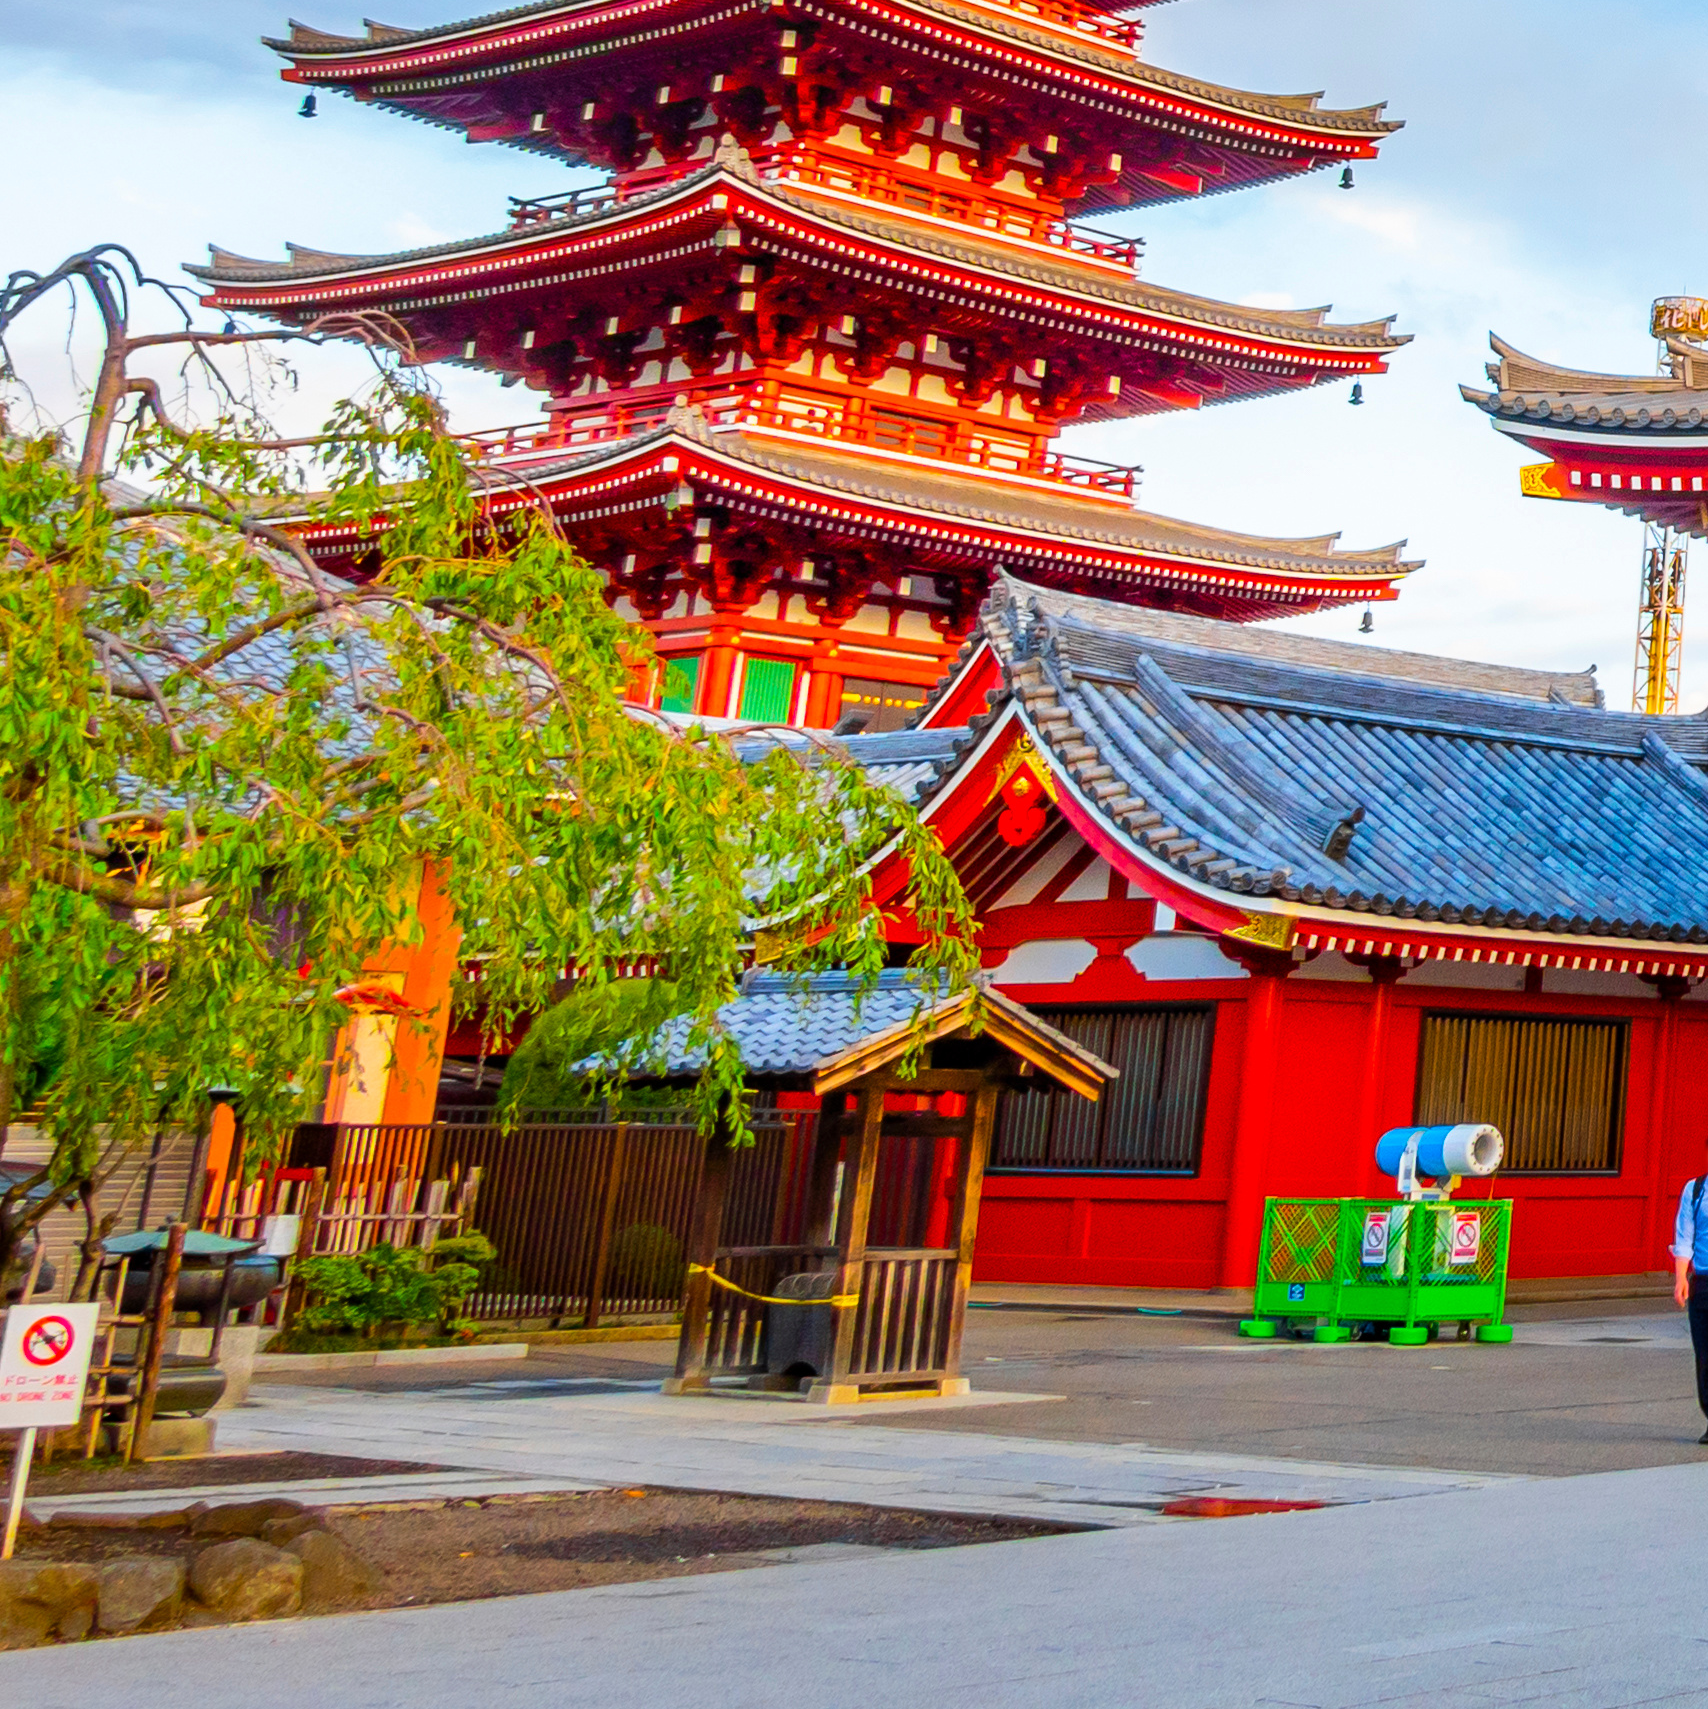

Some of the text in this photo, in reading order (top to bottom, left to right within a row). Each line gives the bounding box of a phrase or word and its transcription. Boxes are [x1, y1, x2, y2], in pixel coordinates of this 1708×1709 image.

[4, 1374, 79, 1386] ドローン禁止
